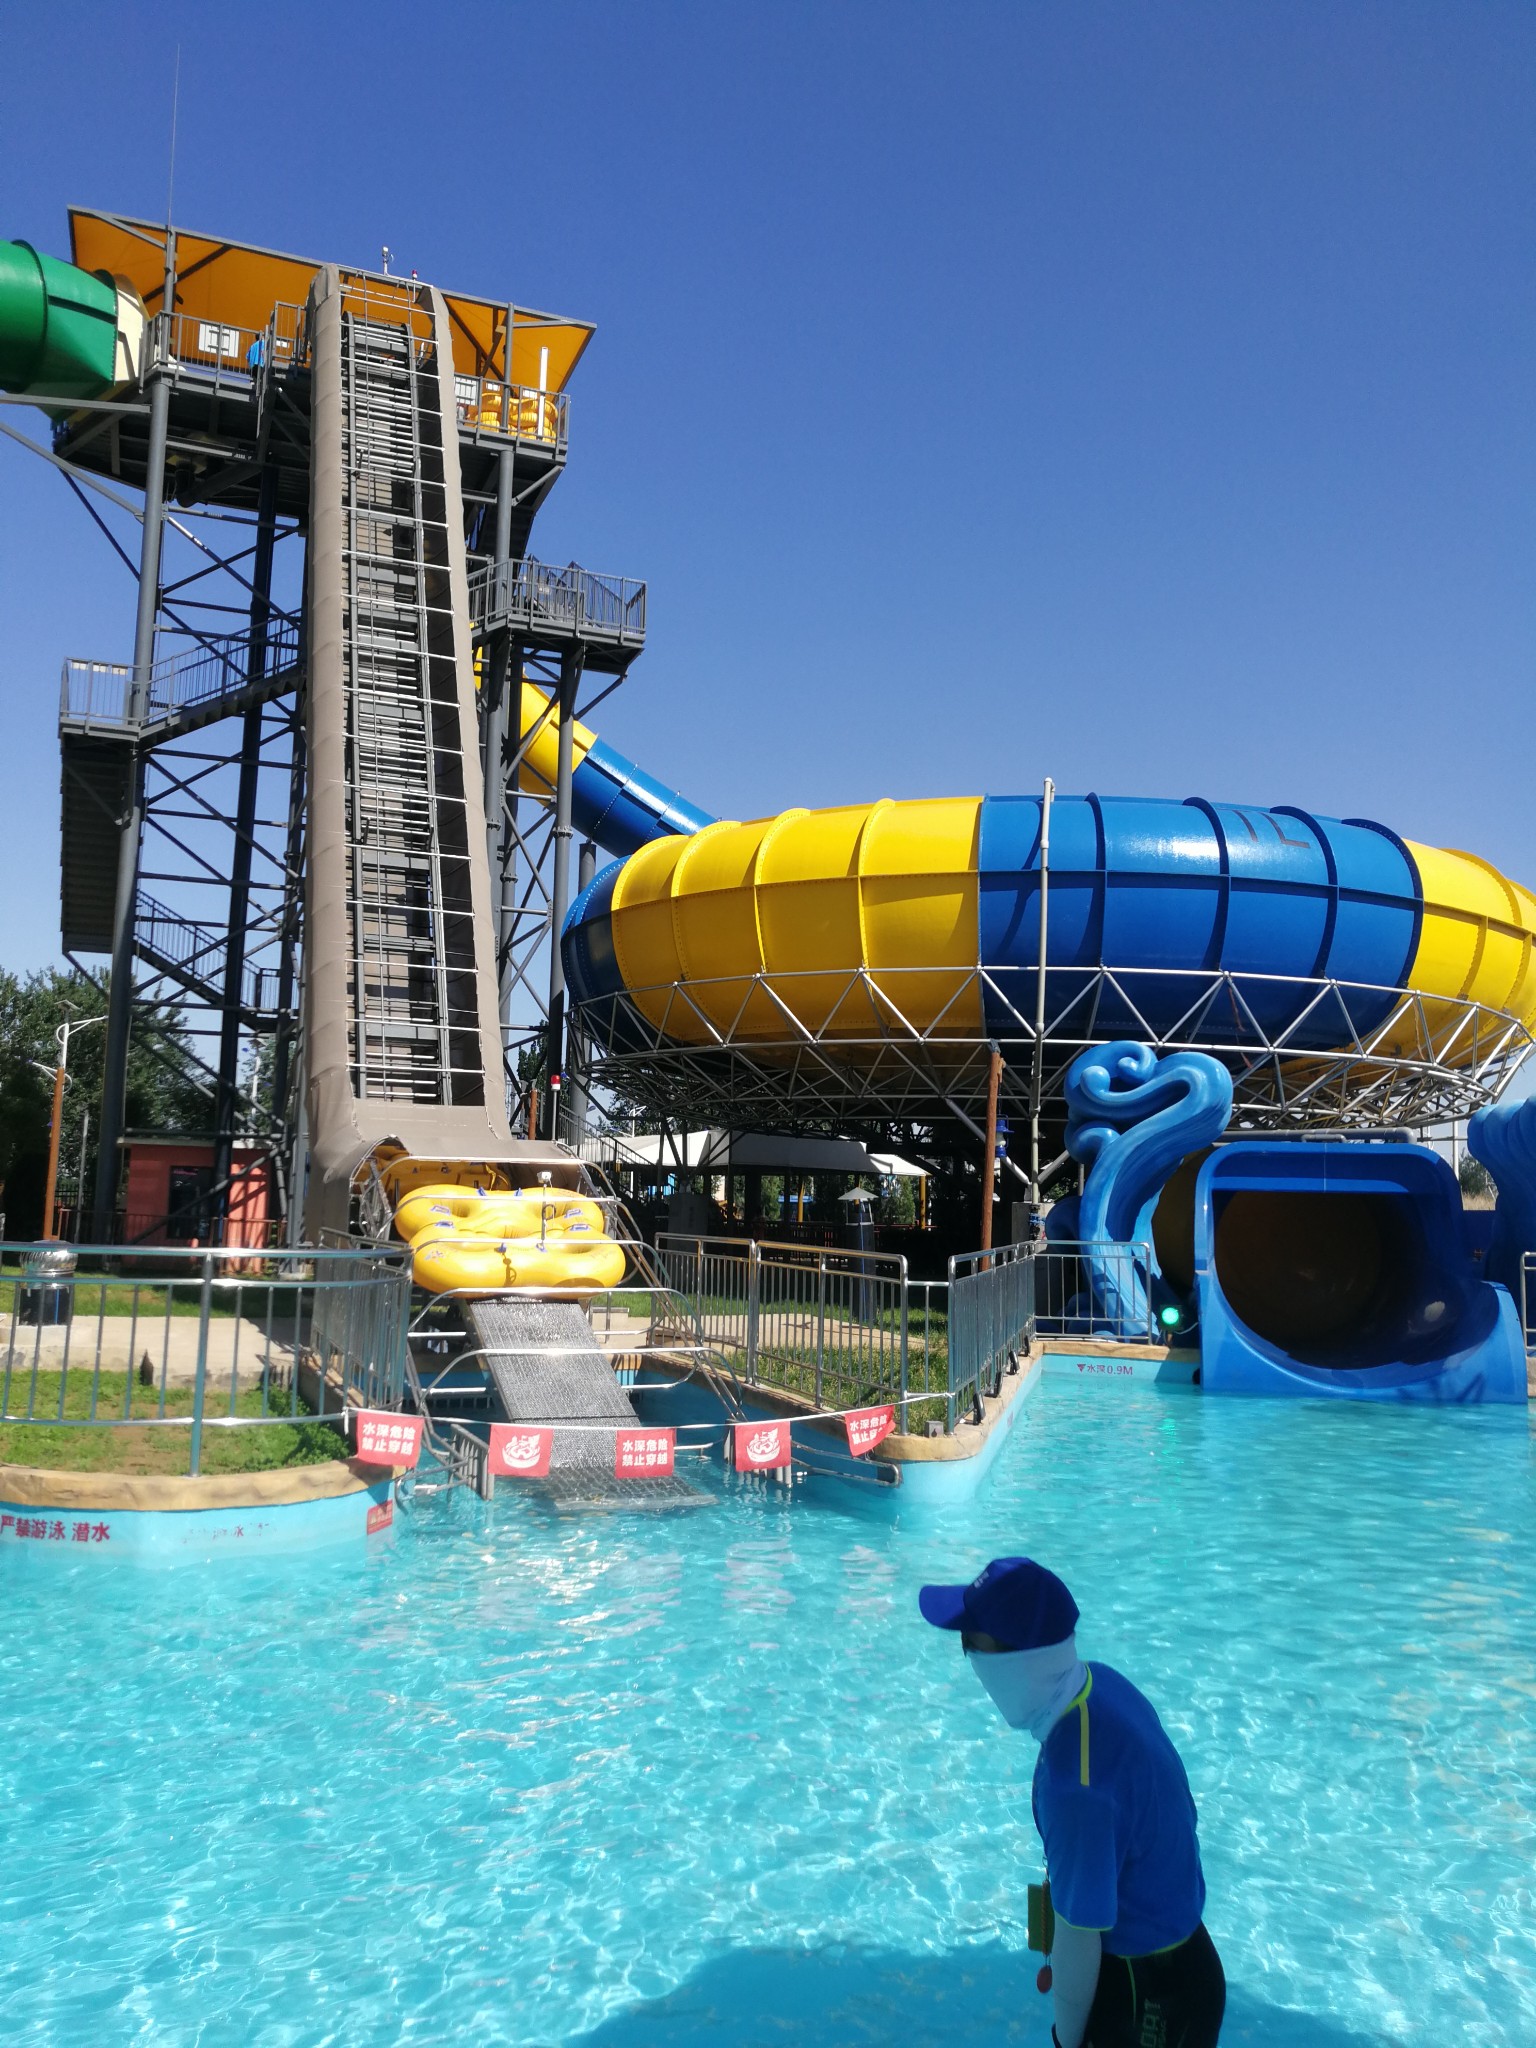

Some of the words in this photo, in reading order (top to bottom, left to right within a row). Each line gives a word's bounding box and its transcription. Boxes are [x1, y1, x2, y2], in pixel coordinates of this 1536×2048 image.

[362, 1422, 416, 1440] 水深危险
[850, 1414, 887, 1431] 水深危险
[622, 1438, 668, 1452] 水深危险
[852, 1427, 883, 1445] 禁止穿
[362, 1437, 414, 1456] 禁止穿越
[622, 1452, 668, 1466] 禁止穿越
[71, 1521, 111, 1542] 潜水
